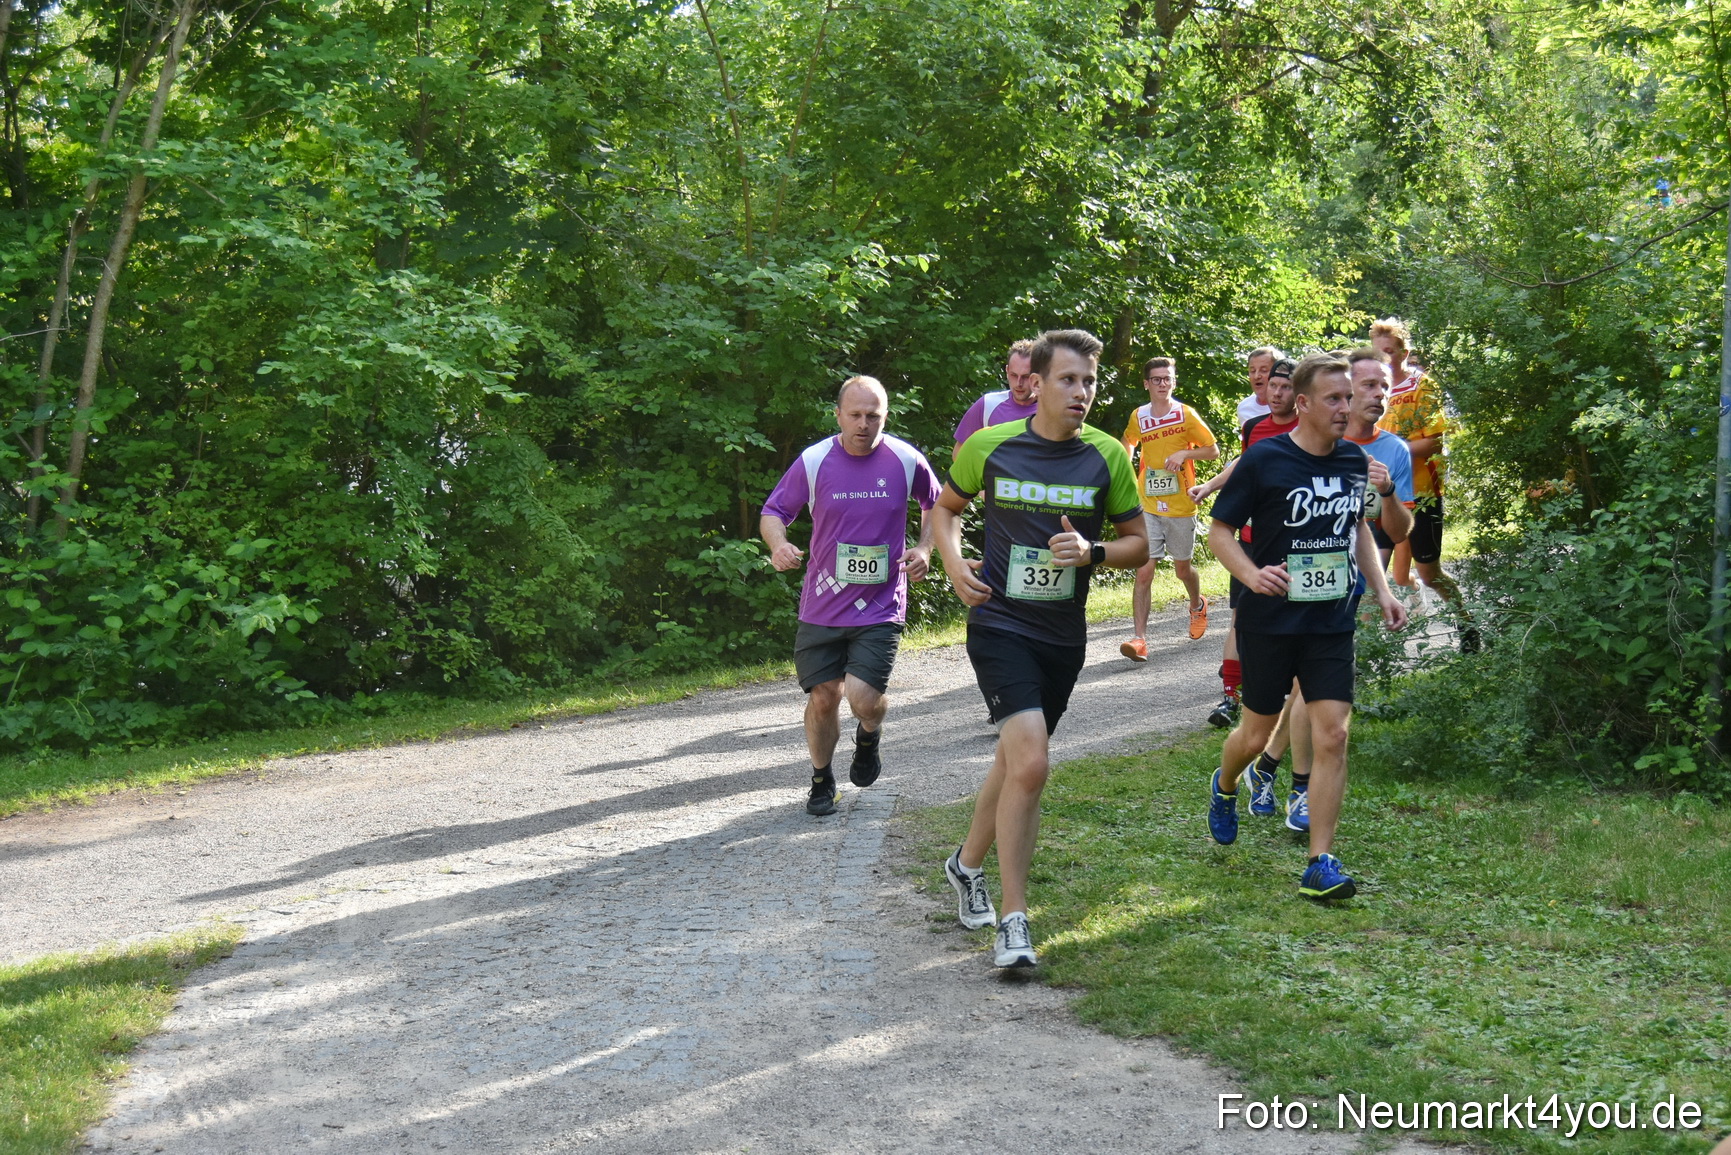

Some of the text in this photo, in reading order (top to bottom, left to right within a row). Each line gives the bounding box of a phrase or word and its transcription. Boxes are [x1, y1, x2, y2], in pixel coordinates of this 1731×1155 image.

[1141, 426, 1186, 443] MAX BÖGL
[1148, 477, 1173, 489] 1557
[849, 491, 868, 499] SIND
[995, 477, 1100, 509] BOCK
[995, 500, 1024, 511] inspired
[1026, 505, 1037, 513] by
[847, 559, 878, 573] 890
[1023, 567, 1064, 586] 337
[1302, 570, 1336, 588] 384
